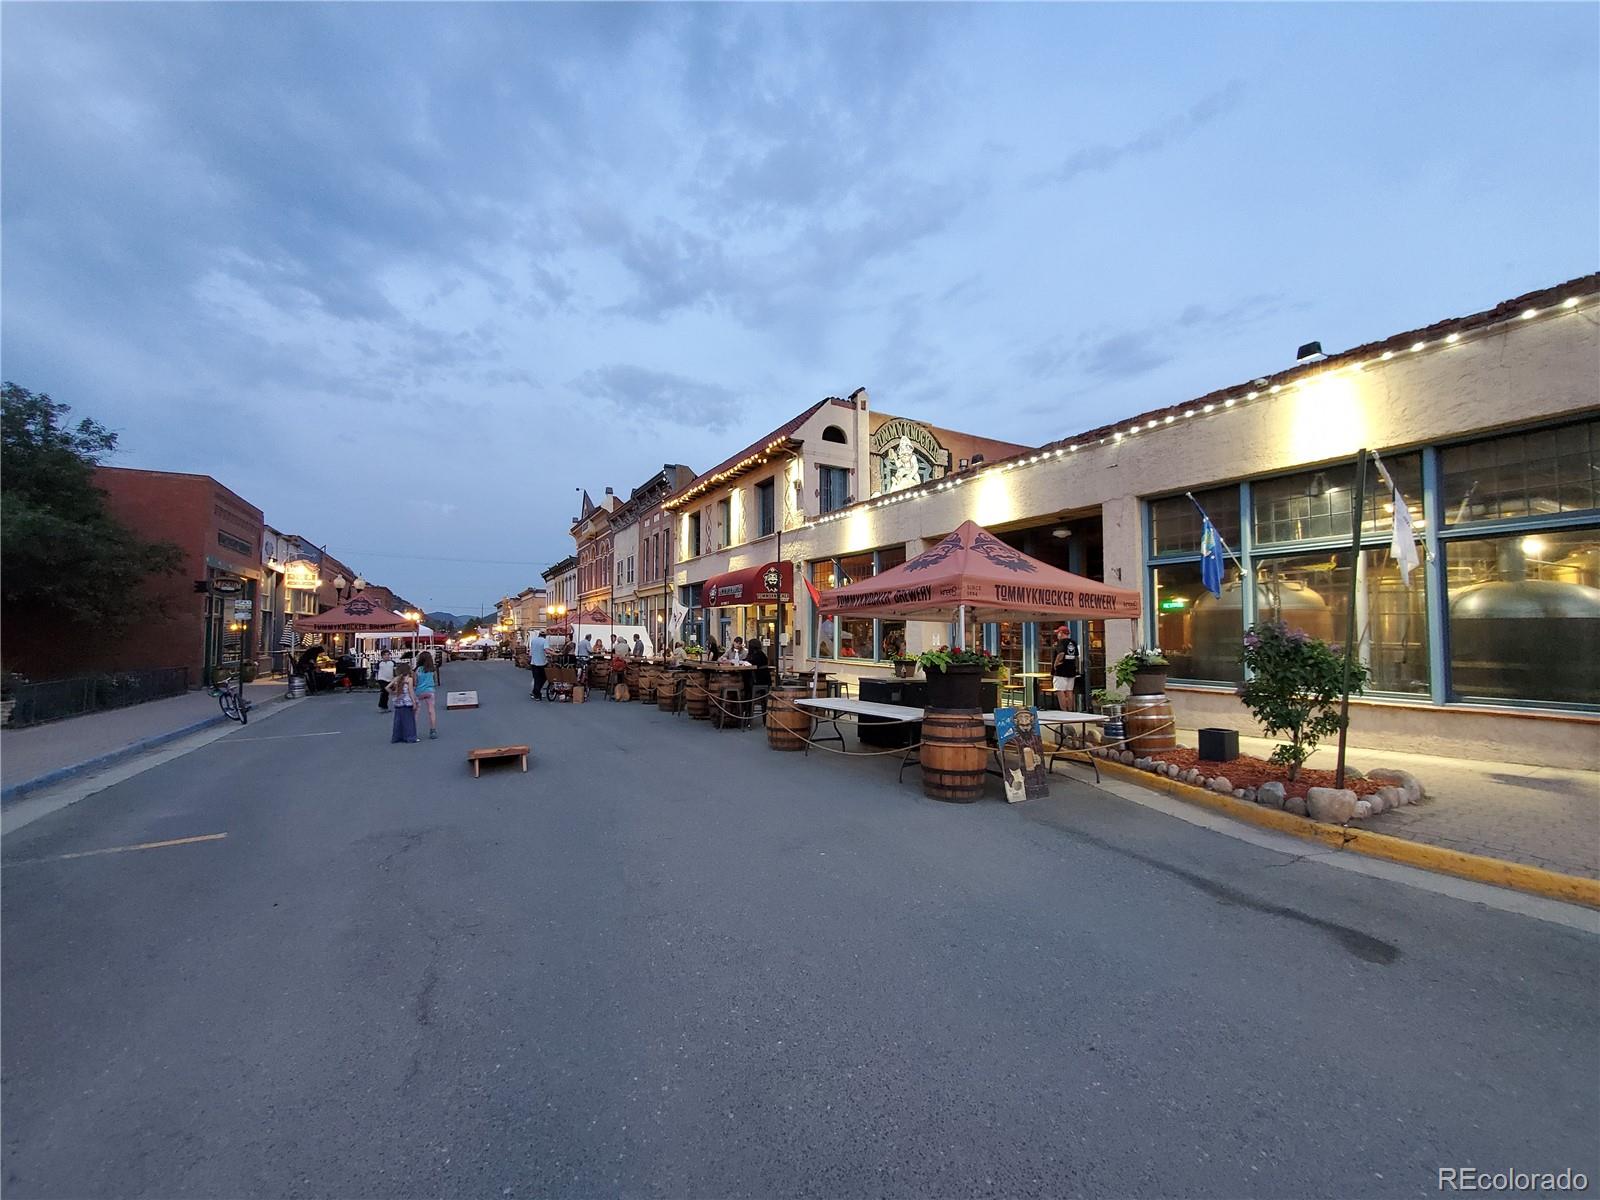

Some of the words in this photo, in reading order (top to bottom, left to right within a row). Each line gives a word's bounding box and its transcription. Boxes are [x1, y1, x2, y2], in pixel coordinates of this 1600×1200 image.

[873, 421, 939, 461] TOMMYKNOCKER
[836, 591, 892, 608] TOMMYKNOCKER
[894, 585, 932, 604] BREWERY
[994, 584, 1075, 608] TOMMYKNOCKER
[1078, 592, 1117, 611] BREWERY
